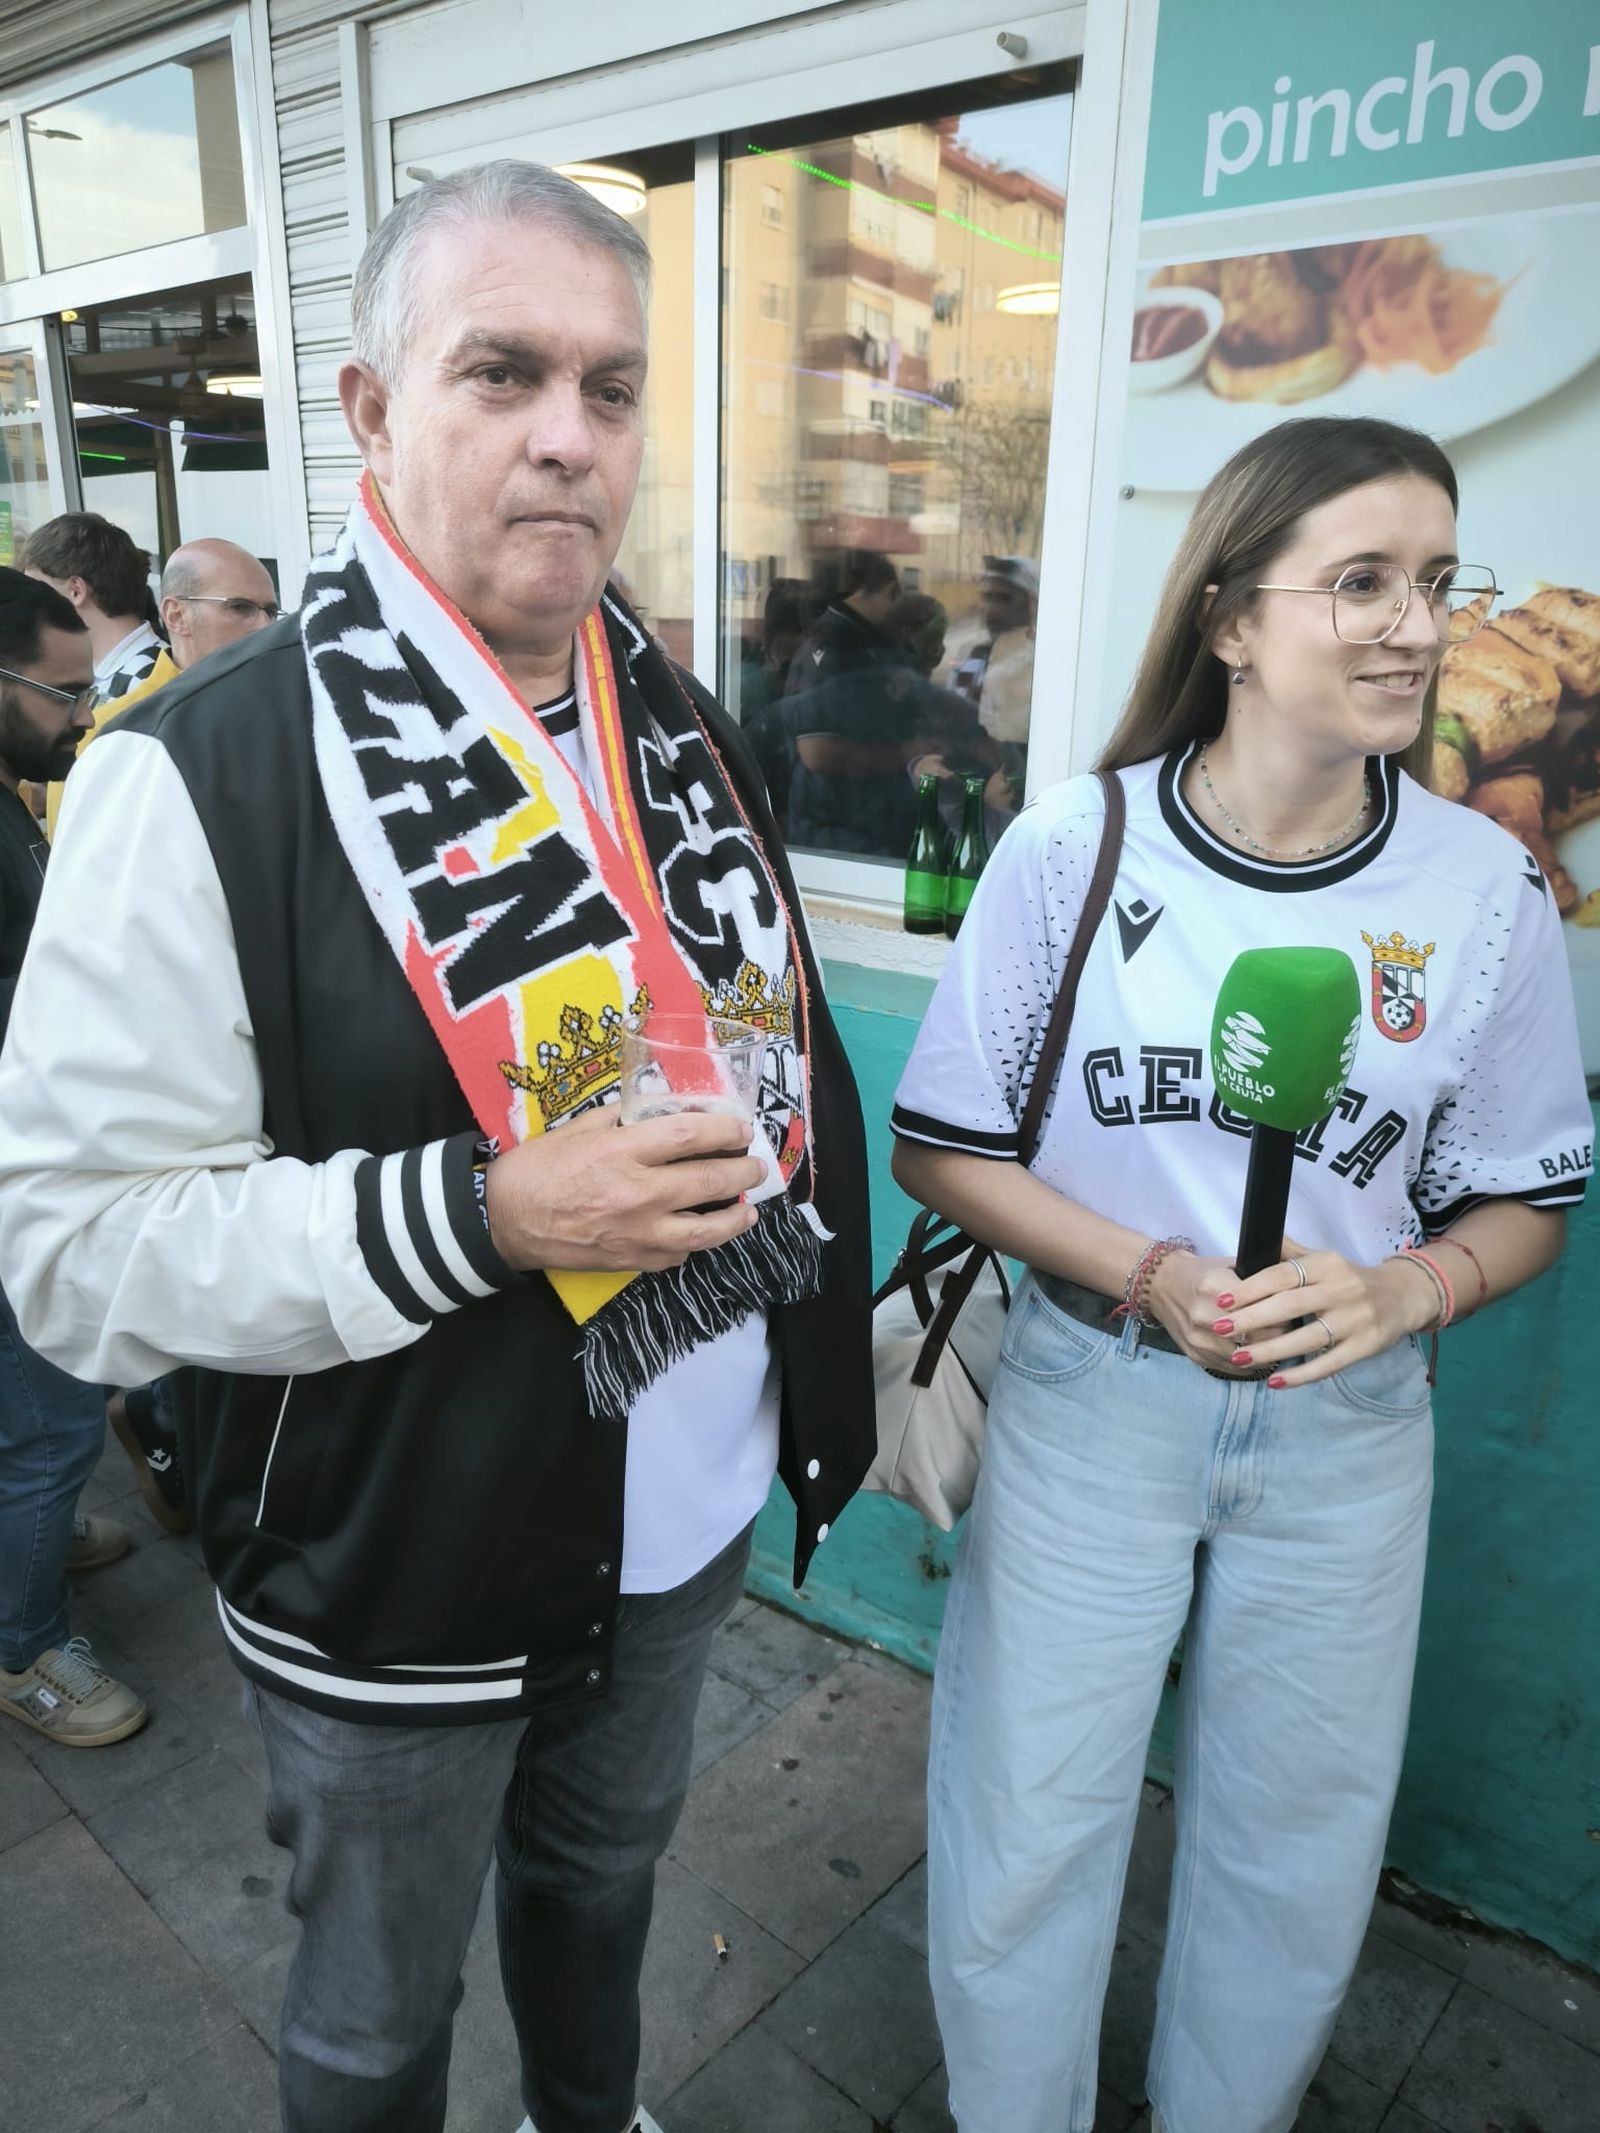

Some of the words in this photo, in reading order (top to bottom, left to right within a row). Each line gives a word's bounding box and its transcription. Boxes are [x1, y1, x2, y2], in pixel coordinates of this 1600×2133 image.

[1202, 40, 1543, 197] pincho
[1221, 1063, 1275, 1098] PUEBLO
[1229, 1081, 1264, 1104] CEUTA
